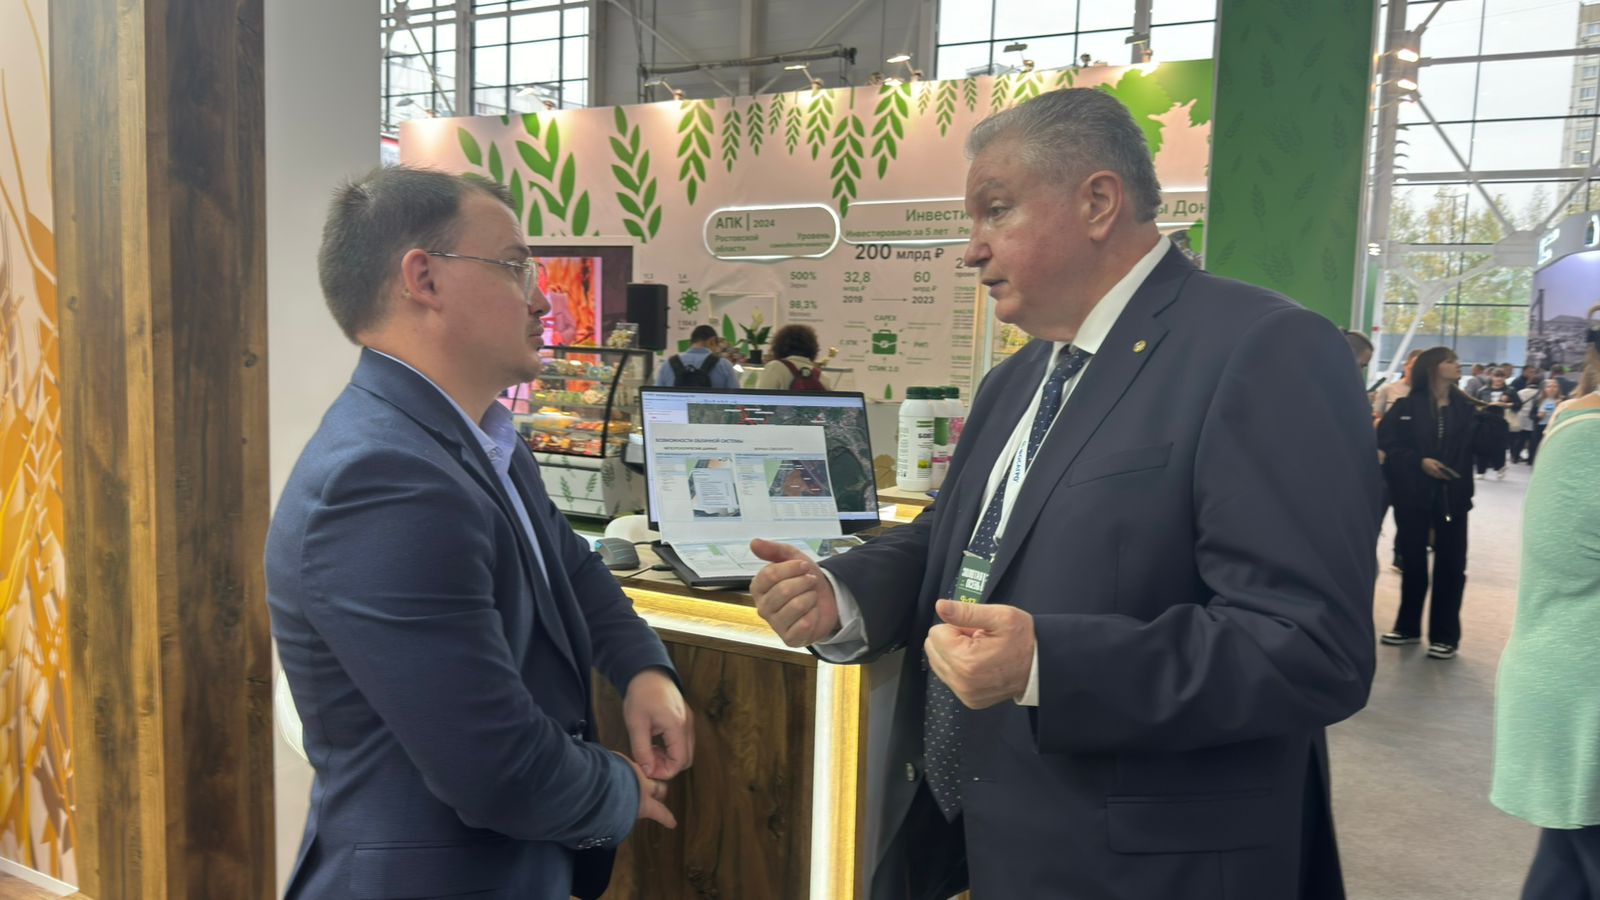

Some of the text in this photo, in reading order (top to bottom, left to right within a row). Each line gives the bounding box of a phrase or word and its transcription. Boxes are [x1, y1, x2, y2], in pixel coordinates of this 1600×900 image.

[906, 209, 971, 222] Инвести
[715, 216, 775, 229] АПК 2024
[715, 234, 759, 242] Ростовской
[797, 232, 831, 241] Уровень
[846, 229, 912, 238] Инвестировано
[855, 243, 892, 260] 200
[896, 250, 931, 262] млрд
[789, 271, 817, 281] 500%
[843, 271, 871, 284] 32,8
[913, 271, 931, 283] 60
[842, 295, 864, 304] 2019
[911, 295, 935, 304] 2023
